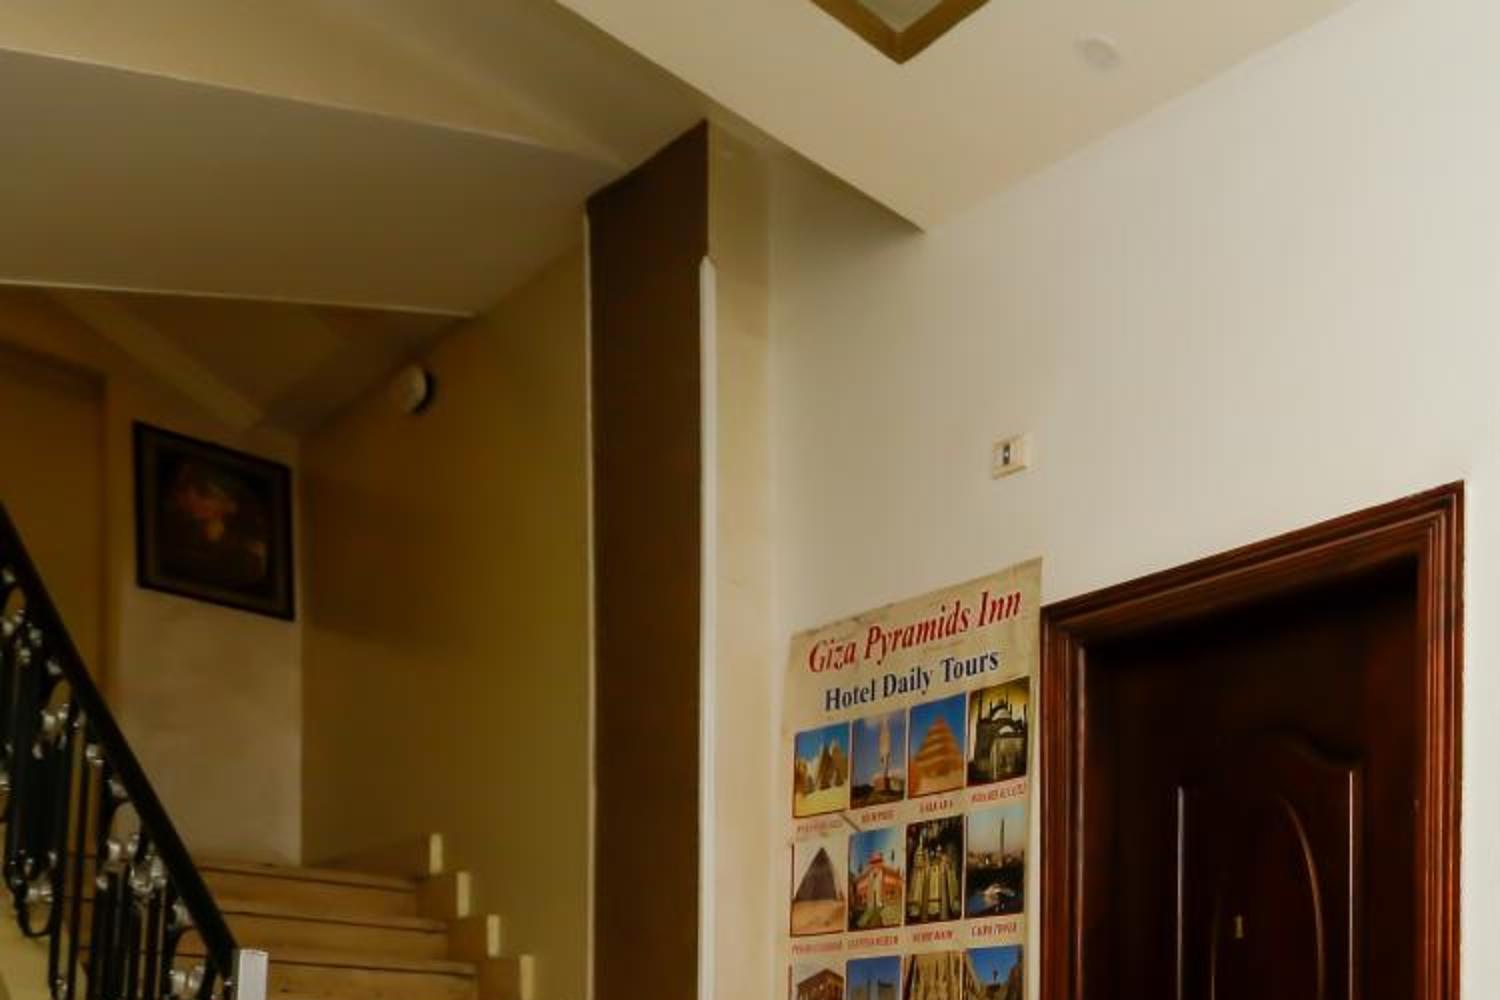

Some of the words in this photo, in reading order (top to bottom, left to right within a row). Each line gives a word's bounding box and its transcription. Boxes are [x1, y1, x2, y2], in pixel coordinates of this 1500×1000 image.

[809, 639, 857, 673] Giza
[863, 600, 971, 666] Pyramids
[977, 591, 1022, 628] Inn
[825, 679, 875, 712] Hotel
[883, 665, 933, 695] Daily
[941, 651, 1000, 683] Tours
